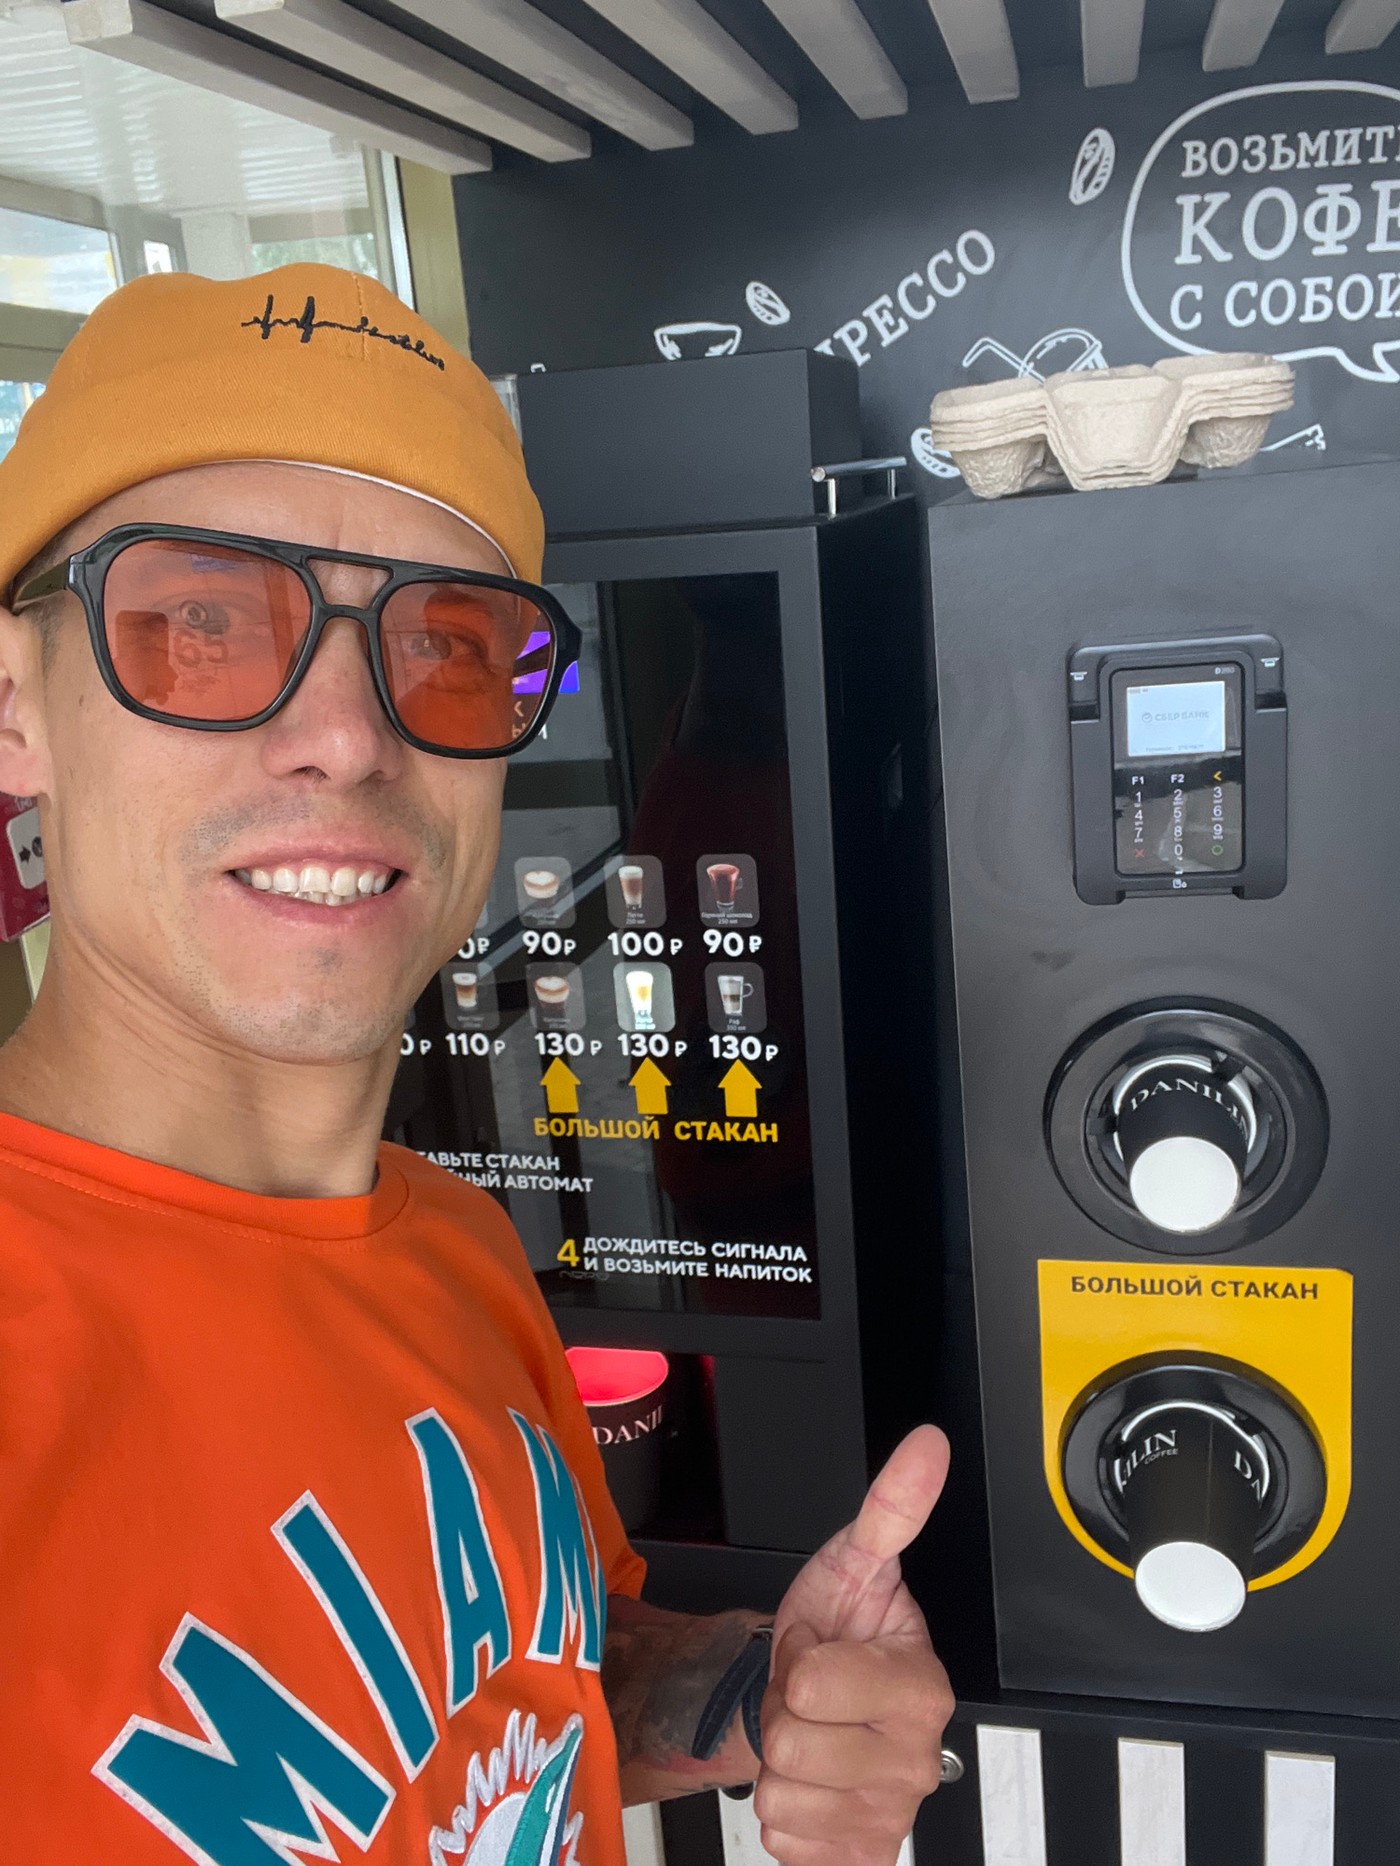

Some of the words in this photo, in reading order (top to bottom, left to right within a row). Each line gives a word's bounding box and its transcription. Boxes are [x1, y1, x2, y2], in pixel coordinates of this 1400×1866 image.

[1182, 125, 1400, 177] ВОЗЬМИТ
[813, 229, 995, 368] РЕССО
[1170, 284, 1204, 330] С
[1131, 776, 1145, 786] F1
[1170, 773, 1185, 784] F2
[1135, 791, 1142, 803] 1
[1173, 788, 1183, 801] 2
[1213, 786, 1223, 799] 3
[1134, 809, 1144, 821] 4
[1173, 806, 1183, 819] 5
[1213, 805, 1223, 817] 6
[1134, 827, 1143, 839] 7
[1173, 825, 1183, 838] 8
[1213, 823, 1223, 836] 9
[1174, 843, 1184, 856] 0
[534, 1115, 660, 1139] БОЛЬШОЙ
[674, 1120, 778, 1143] СТАКАН
[485, 1153, 560, 1172] СТАКАН
[504, 1173, 594, 1192] АВТОМАТ
[556, 1238, 580, 1268] 4
[583, 1236, 707, 1256] ДОЖДИТЕСЬ
[711, 1242, 808, 1262] СИГНАЛА
[583, 1256, 599, 1271] И
[603, 1257, 709, 1278] ВОЗЬМИТЕ
[715, 1263, 813, 1284] НАПИТОК
[1071, 1275, 1203, 1297] БОЛЬШОЙ
[1211, 1280, 1319, 1300] СТАКАН
